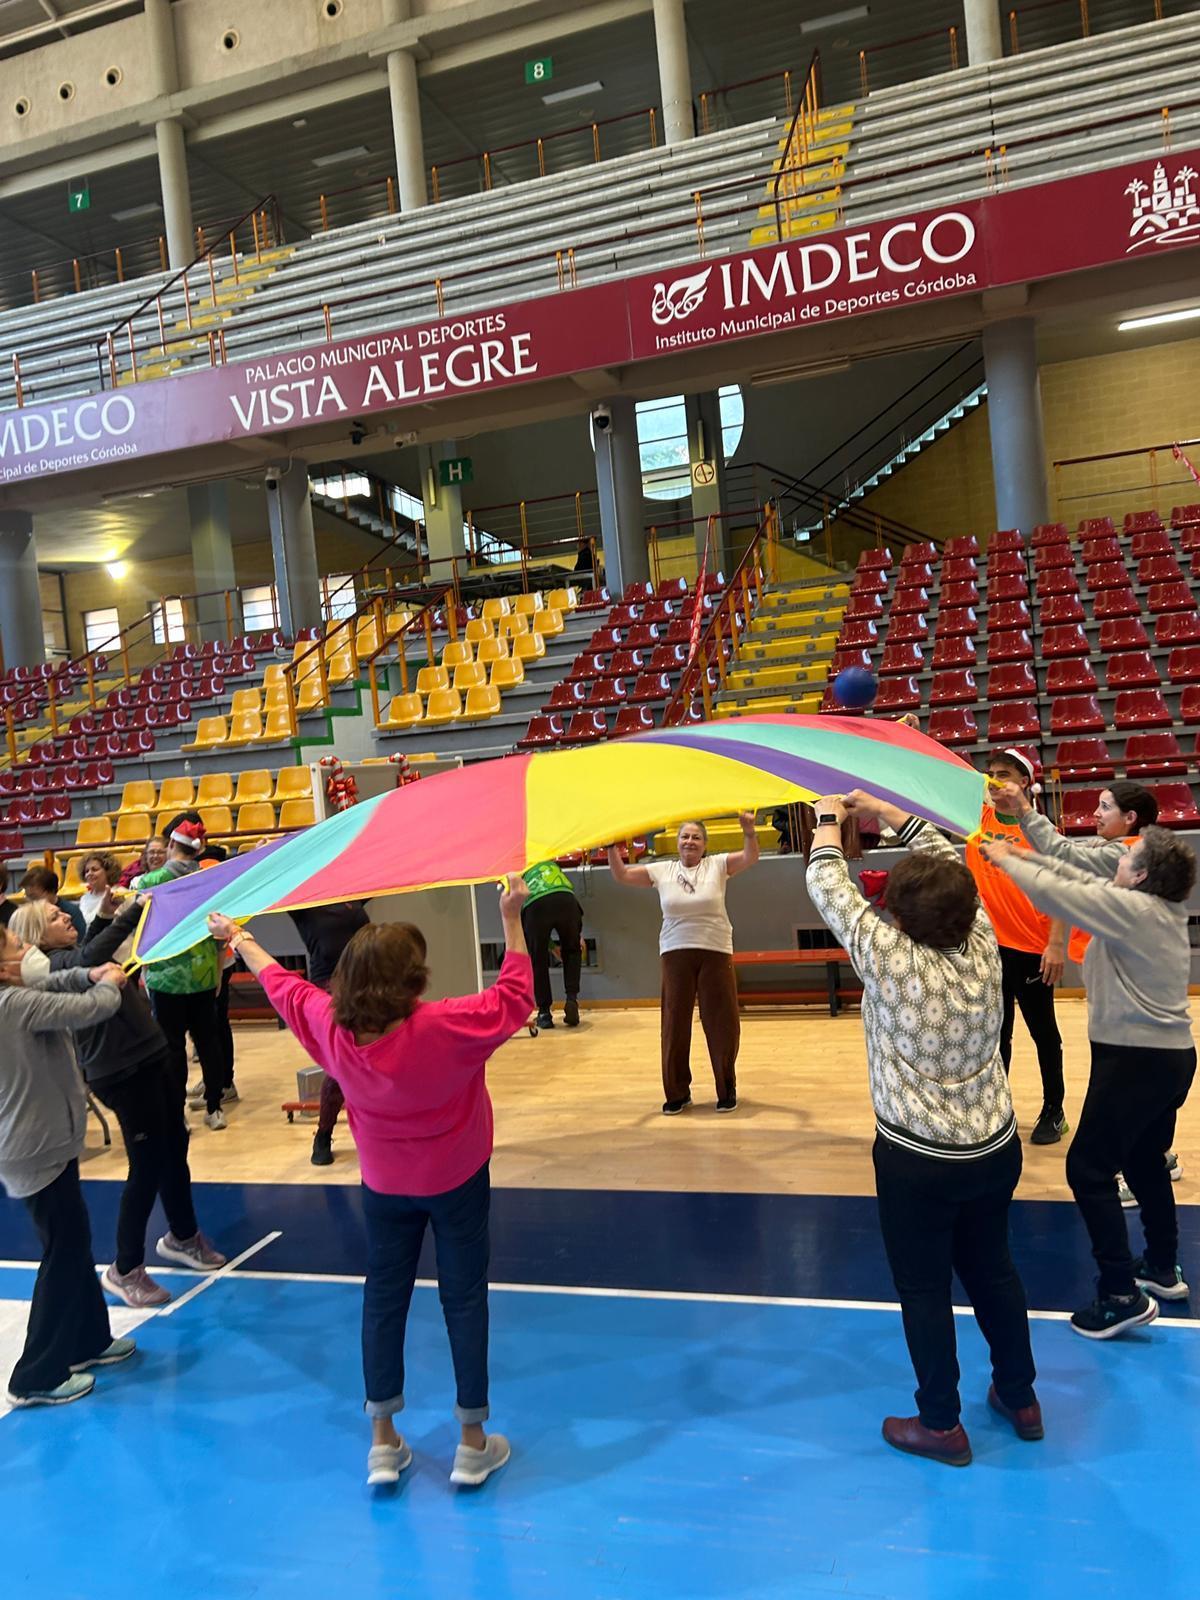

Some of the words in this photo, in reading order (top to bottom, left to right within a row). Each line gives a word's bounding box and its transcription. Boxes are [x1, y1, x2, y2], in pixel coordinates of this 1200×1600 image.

[534, 62, 544, 79] 8
[75, 193, 83, 208] 7
[720, 212, 976, 310] IMDECO
[655, 327, 716, 350] Instituto
[720, 307, 796, 336] Municipal
[800, 304, 820, 319] de
[825, 288, 900, 313] Deportes
[904, 273, 977, 297] Córdoba
[245, 355, 315, 384] PALACIO
[320, 334, 413, 368] MUNICIPAL
[418, 313, 506, 348] DEPORTES
[229, 375, 348, 431] VISTA
[362, 332, 538, 407] ALEGRE
[24, 461, 38, 474] de
[40, 453, 89, 471] Deportes
[90, 442, 138, 461] Córdoba
[449, 461, 462, 480] H
